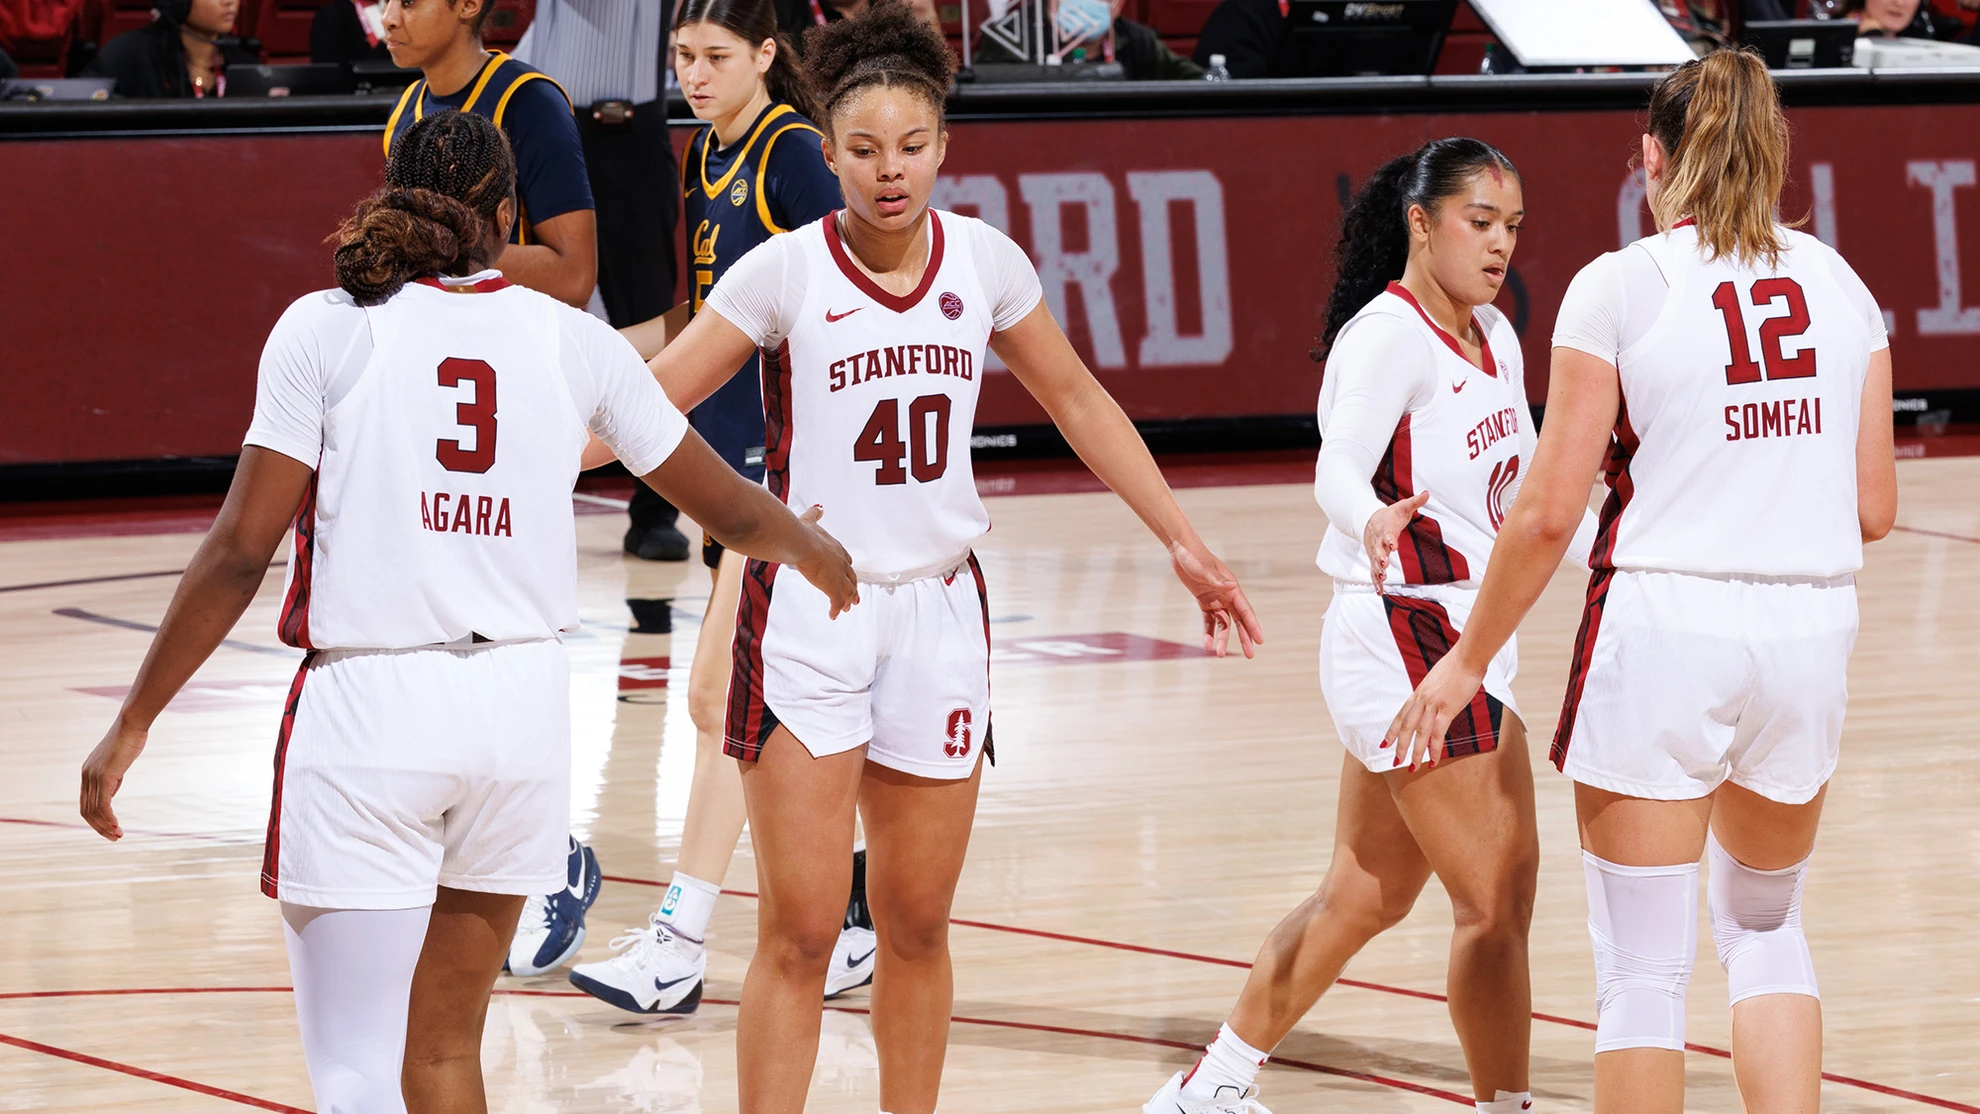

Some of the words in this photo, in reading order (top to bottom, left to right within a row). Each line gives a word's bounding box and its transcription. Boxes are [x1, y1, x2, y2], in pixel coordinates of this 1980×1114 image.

[693, 219, 721, 264] Cal
[1711, 277, 1817, 386] 12
[829, 344, 973, 393] STANFORD
[436, 356, 498, 474] 3
[853, 393, 952, 486] 40
[1466, 407, 1520, 461] STANFO
[1724, 397, 1822, 442] SOMFAI
[421, 490, 512, 538] AGARA
